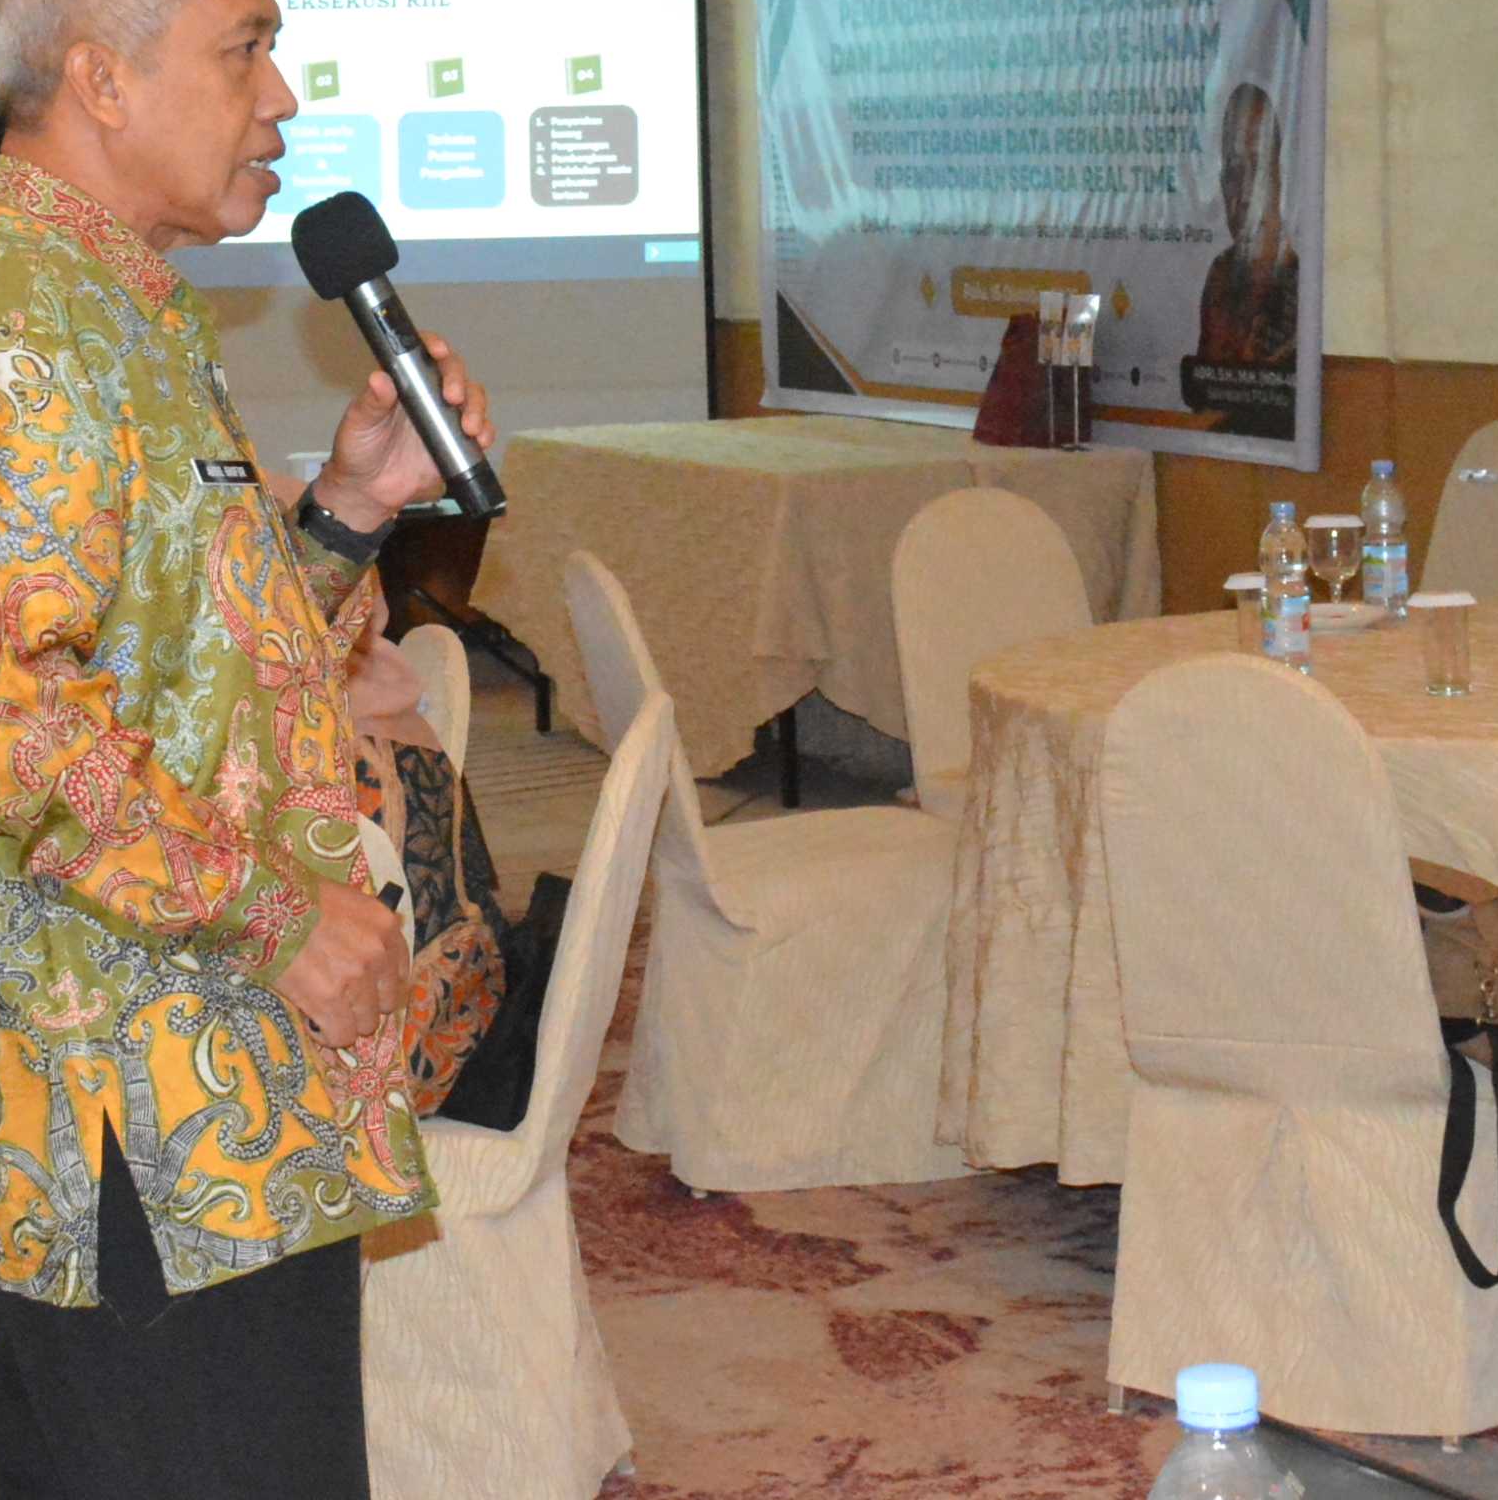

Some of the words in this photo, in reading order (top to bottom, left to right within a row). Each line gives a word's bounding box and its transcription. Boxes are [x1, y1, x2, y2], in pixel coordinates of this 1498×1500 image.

[1004, 24, 1110, 70] APLIKASI
[1088, 85, 1161, 117] DIGITAL
[1165, 83, 1207, 116] DAN
[1006, 125, 1051, 155] DATA
[1054, 125, 1140, 154] PERKARA
[1142, 124, 1204, 154] SERTA
[1009, 164, 1079, 192] SECARA
[1082, 164, 1128, 193] REAL
[1130, 164, 1177, 194] TIME
